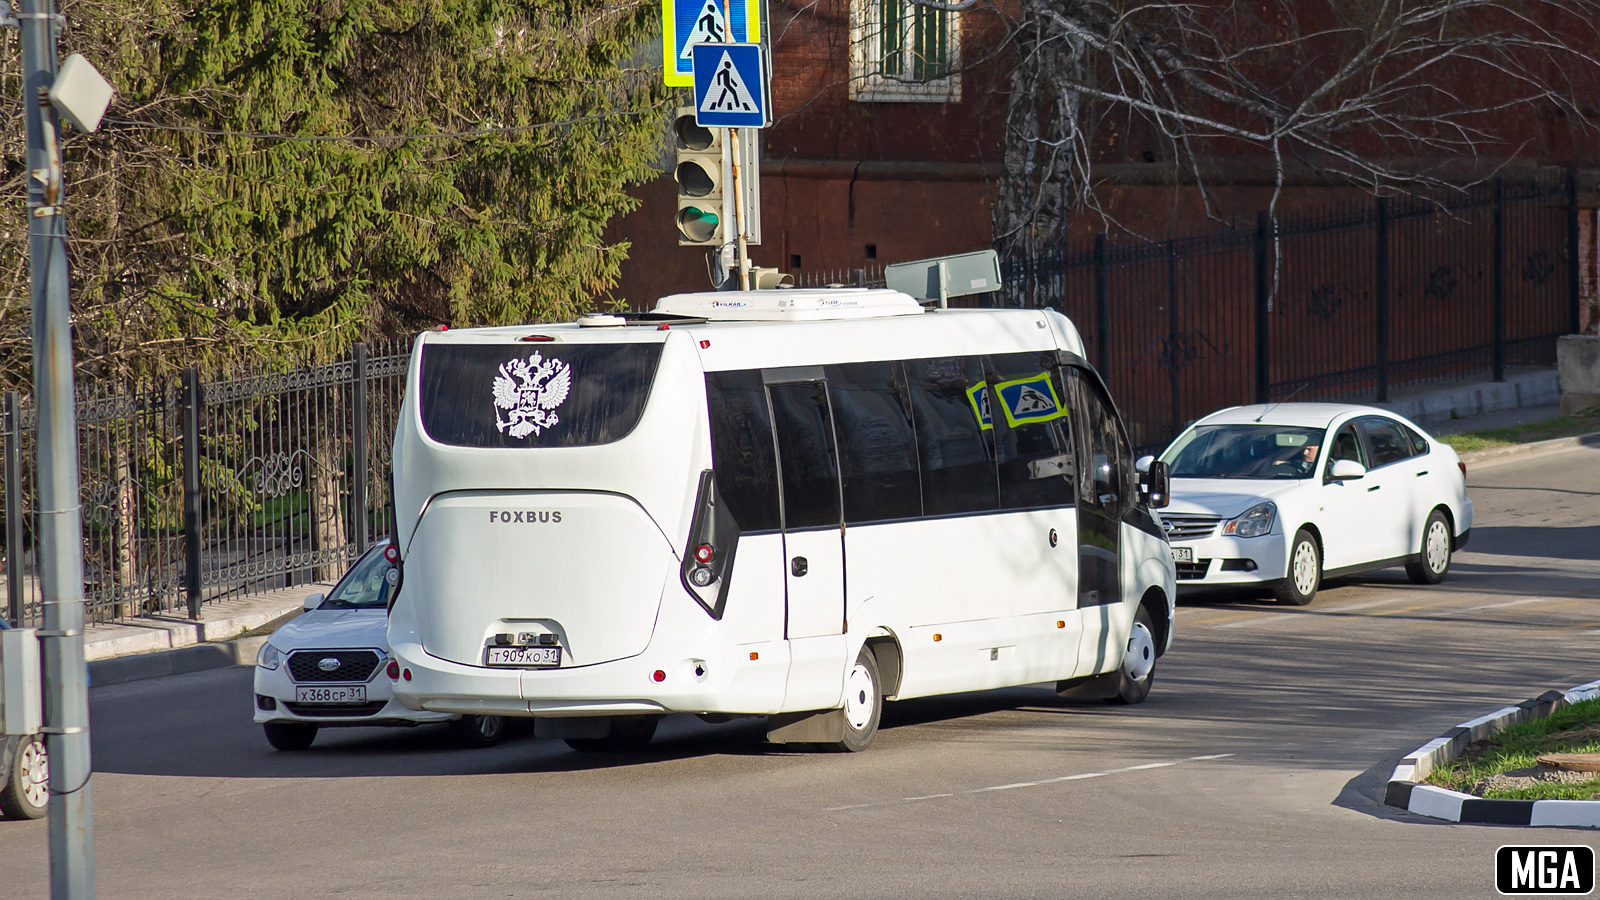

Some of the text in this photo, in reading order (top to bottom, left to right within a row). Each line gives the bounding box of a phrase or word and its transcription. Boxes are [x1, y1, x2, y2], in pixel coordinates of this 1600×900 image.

[489, 511, 562, 523] FOXBUS
[1178, 549, 1188, 558] 31
[543, 649, 557, 660] 31
[349, 687, 361, 698] 31
